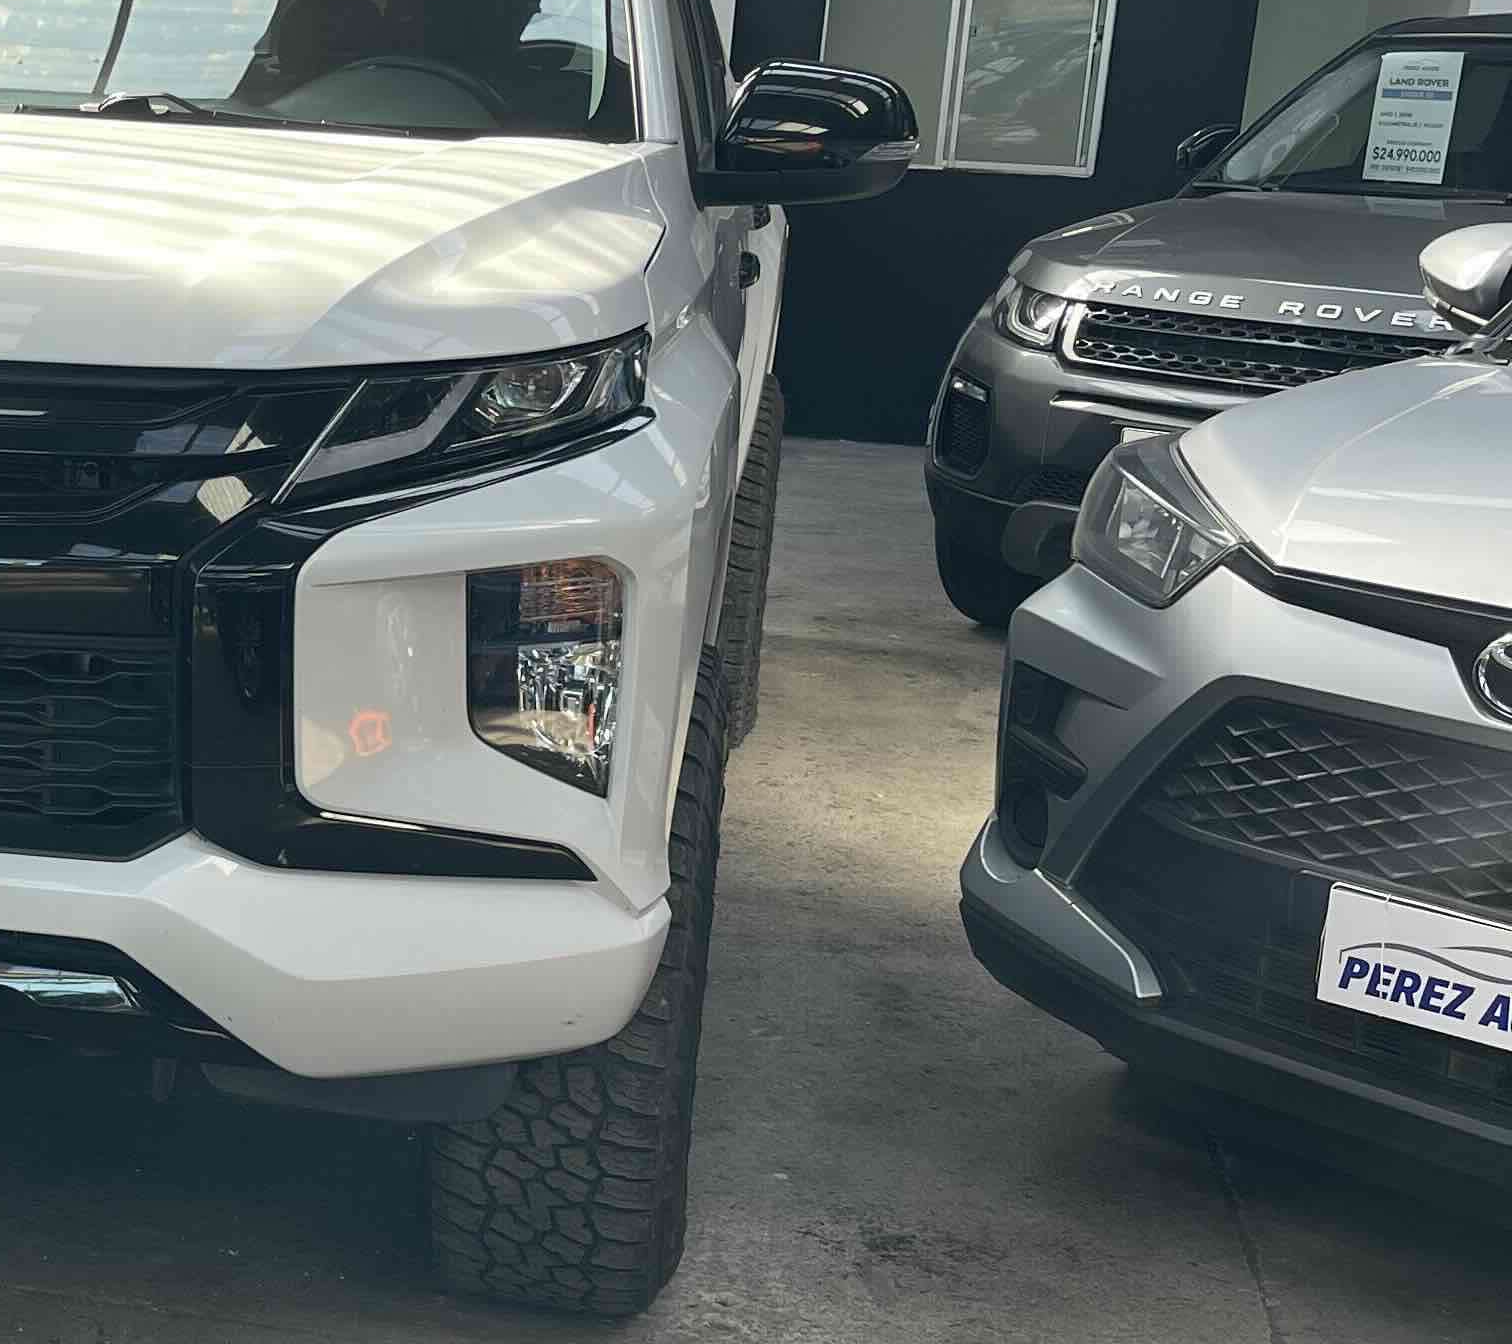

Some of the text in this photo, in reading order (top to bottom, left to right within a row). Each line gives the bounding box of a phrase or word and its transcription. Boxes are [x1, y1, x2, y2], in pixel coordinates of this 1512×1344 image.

[1389, 78, 1450, 89] LAND ROVER
[1372, 146, 1442, 163] $24.990.000
[1090, 280, 1454, 332] RANGE ROVER
[1338, 956, 1476, 1021] PEREZ
